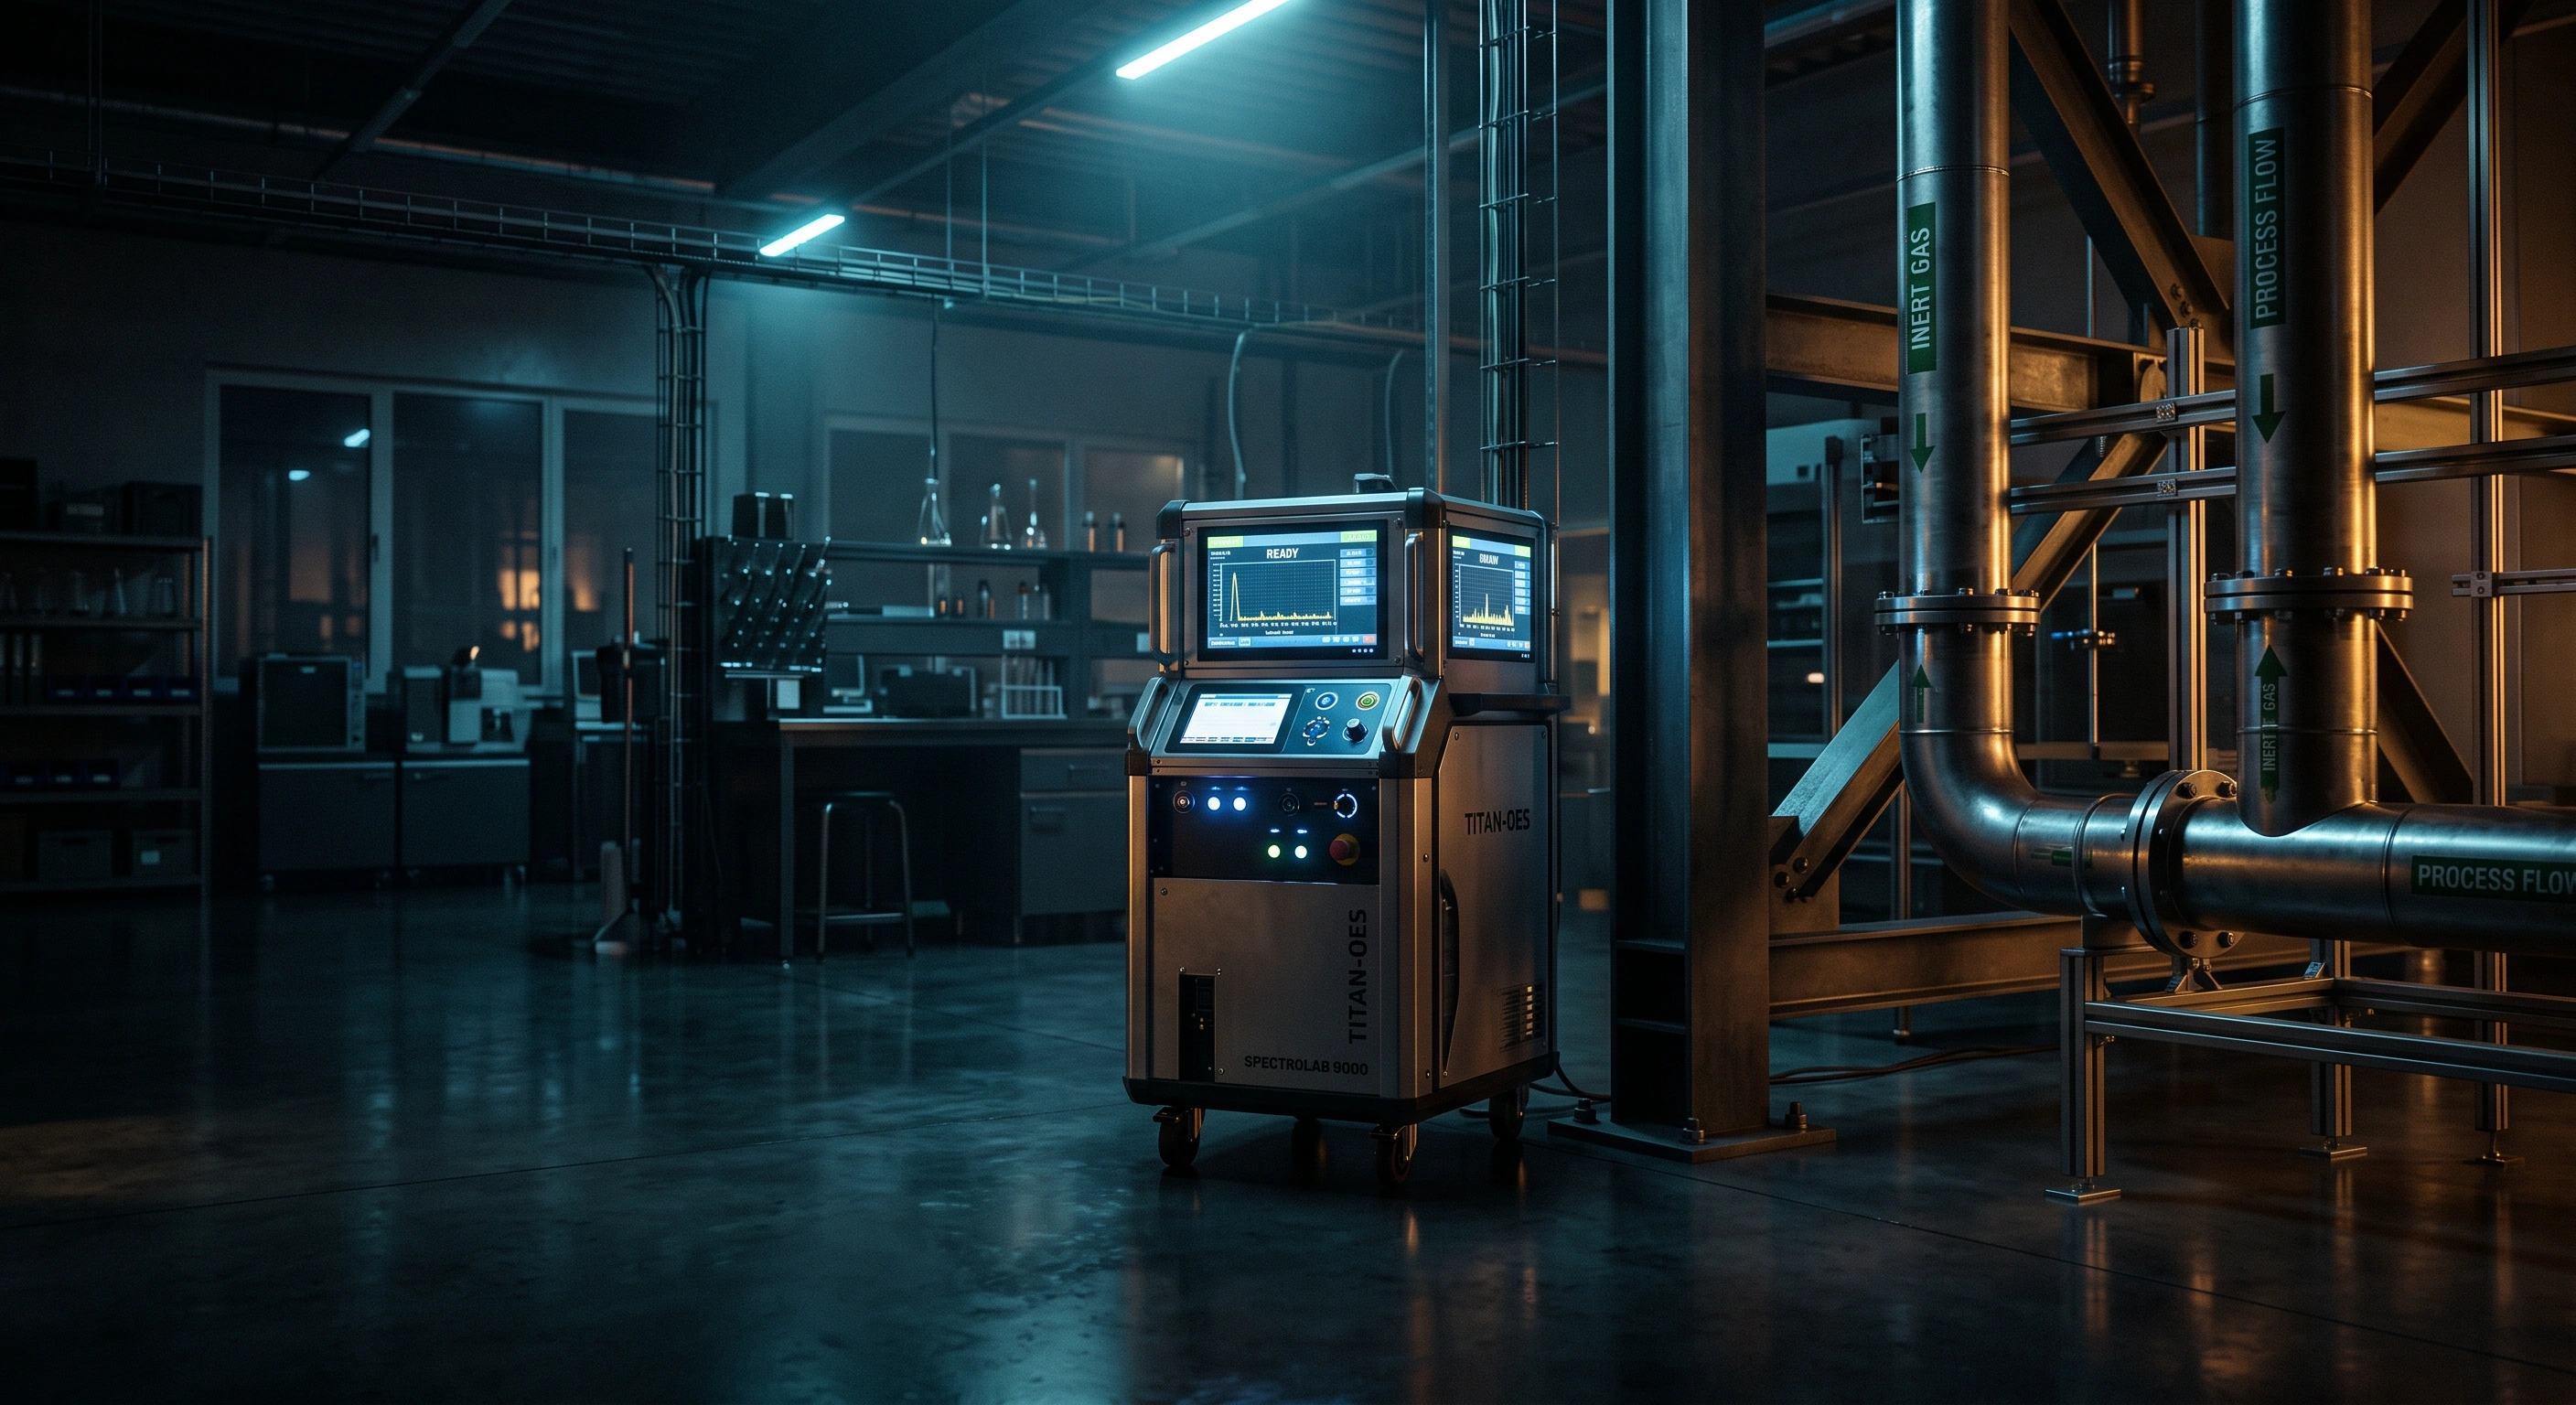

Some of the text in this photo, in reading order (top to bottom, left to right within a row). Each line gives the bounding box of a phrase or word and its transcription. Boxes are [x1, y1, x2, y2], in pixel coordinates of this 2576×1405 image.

[2255, 137, 2278, 318] PROCESS FLOW
[1910, 226, 1931, 350] INERT GAS
[1266, 548, 1299, 559] READY
[2262, 683, 2276, 711] GAS
[2262, 734, 2277, 771] INERT
[1465, 809, 1530, 835] TITAN-OES
[2418, 863, 2516, 892] PROCESS
[1348, 908, 1368, 1045] TITAN-OES
[1244, 1056, 1368, 1075] SPECTROLAB 9000
